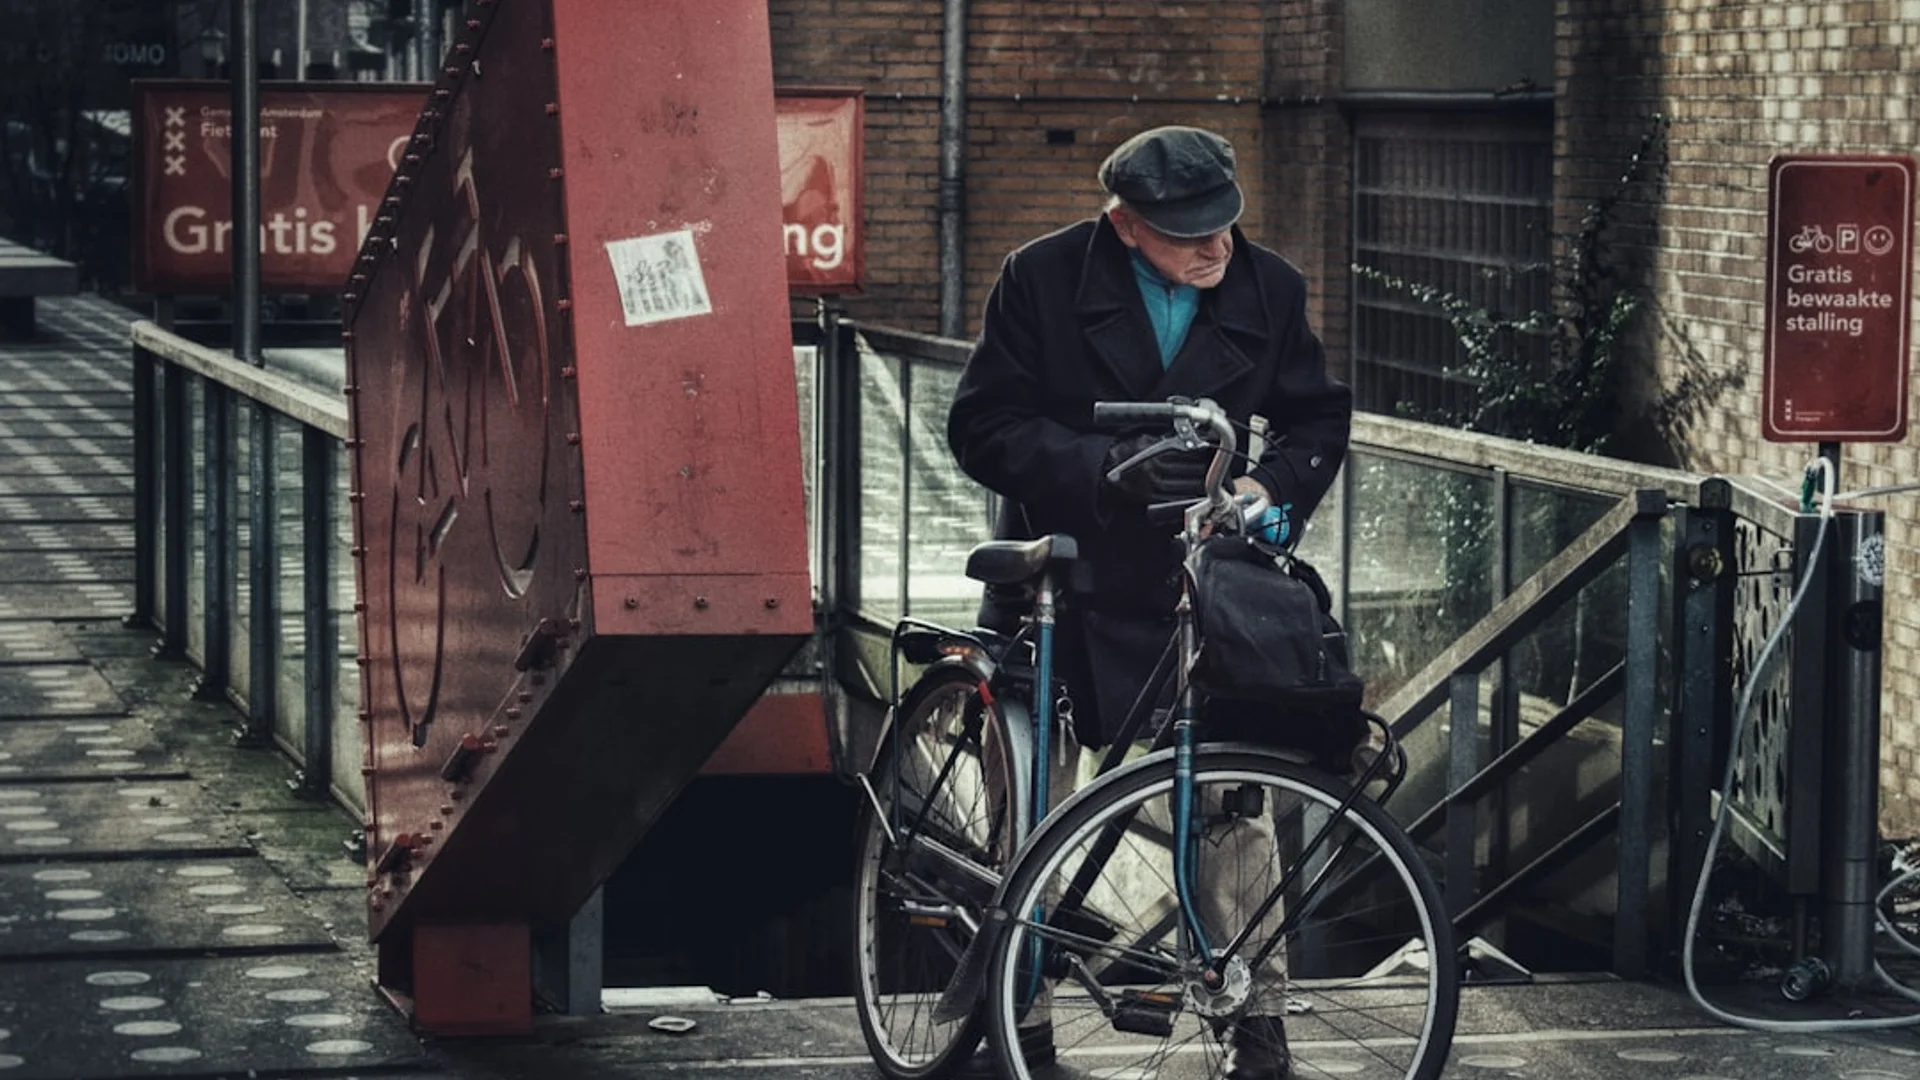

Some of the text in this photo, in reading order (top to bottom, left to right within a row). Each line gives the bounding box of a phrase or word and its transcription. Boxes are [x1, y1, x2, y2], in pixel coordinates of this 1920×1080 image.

[261, 107, 323, 119] Amsterdam
[201, 122, 278, 138] Fietnt
[164, 206, 336, 254] Grtis
[1841, 229, 1856, 249] P
[1787, 264, 1853, 283] Gratis
[1787, 287, 1893, 308] bewaakte
[1786, 311, 1864, 337] stalling
